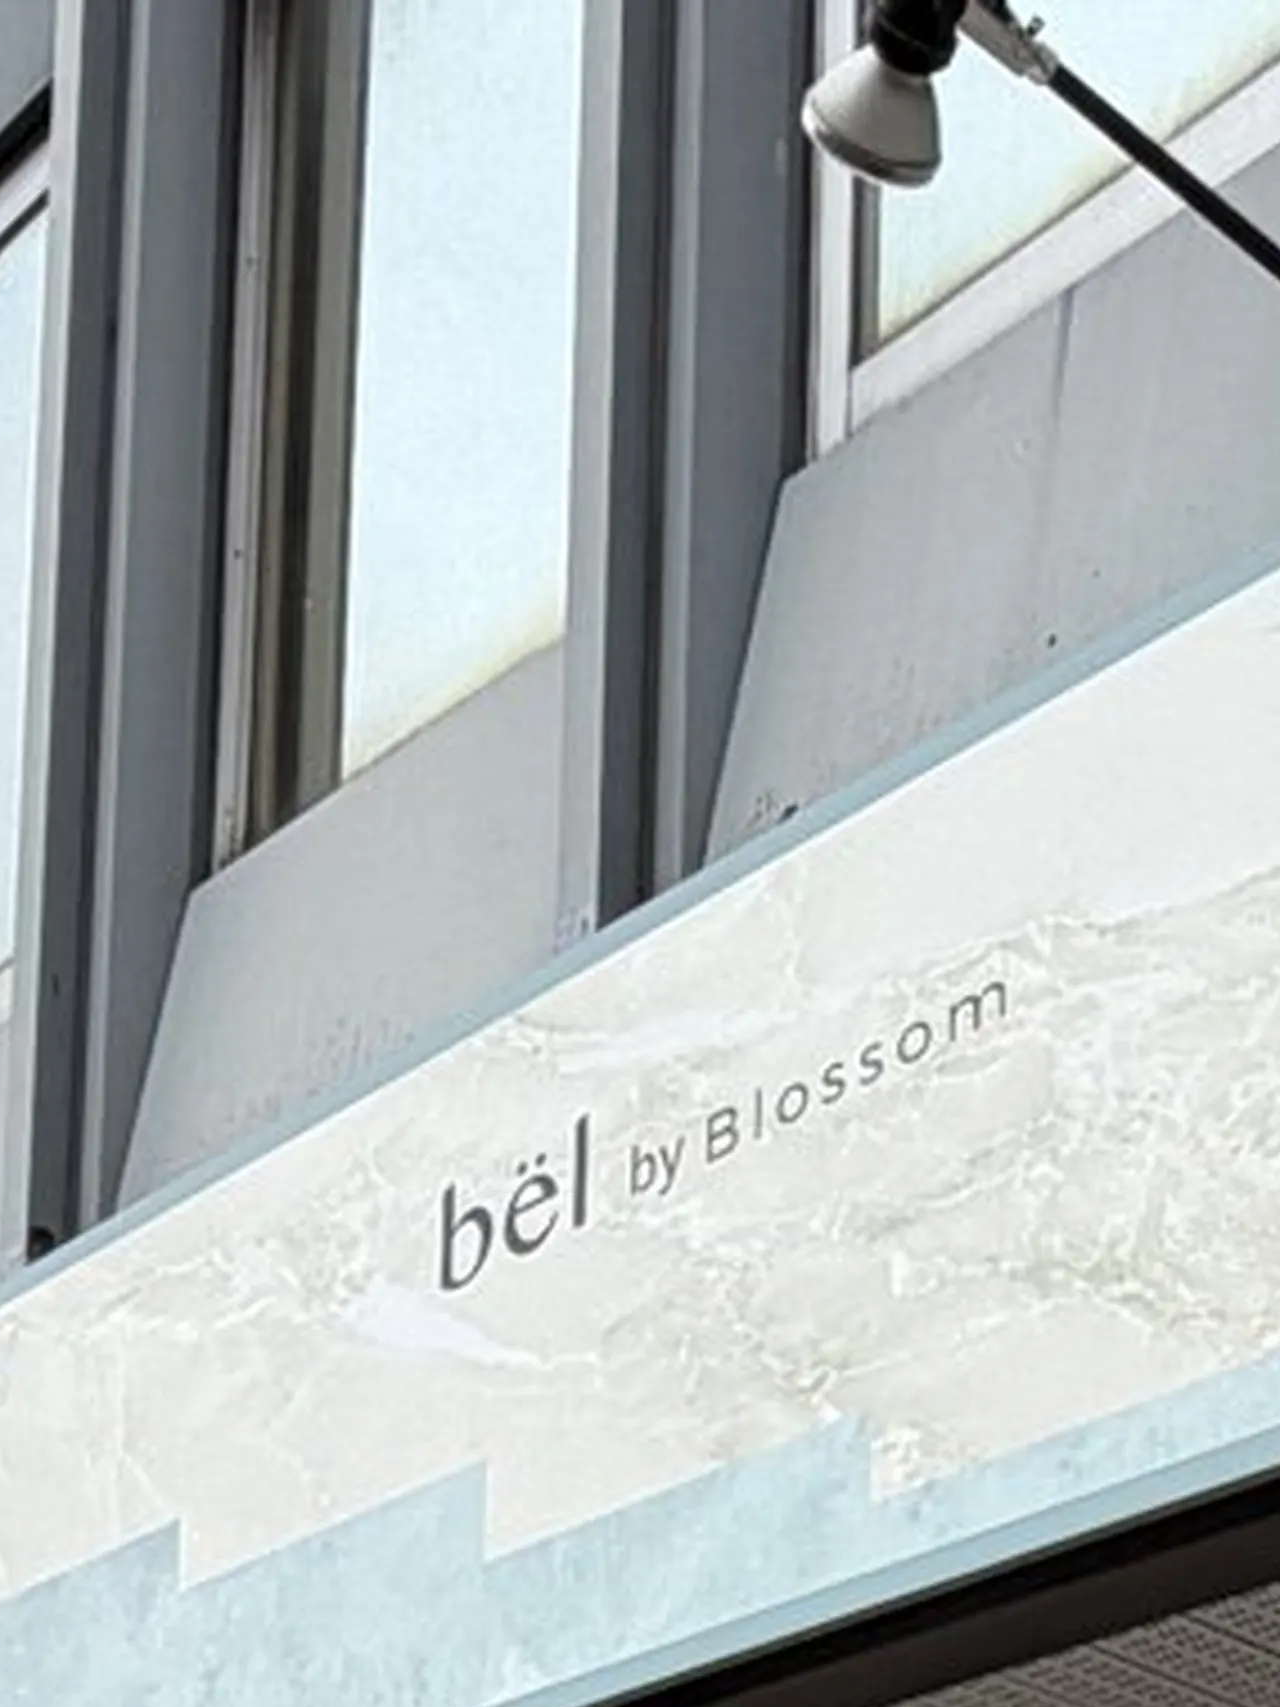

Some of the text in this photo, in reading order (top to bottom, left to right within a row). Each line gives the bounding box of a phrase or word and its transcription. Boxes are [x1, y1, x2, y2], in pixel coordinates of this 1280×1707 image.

[437, 980, 1007, 1291] bël by Blossom
